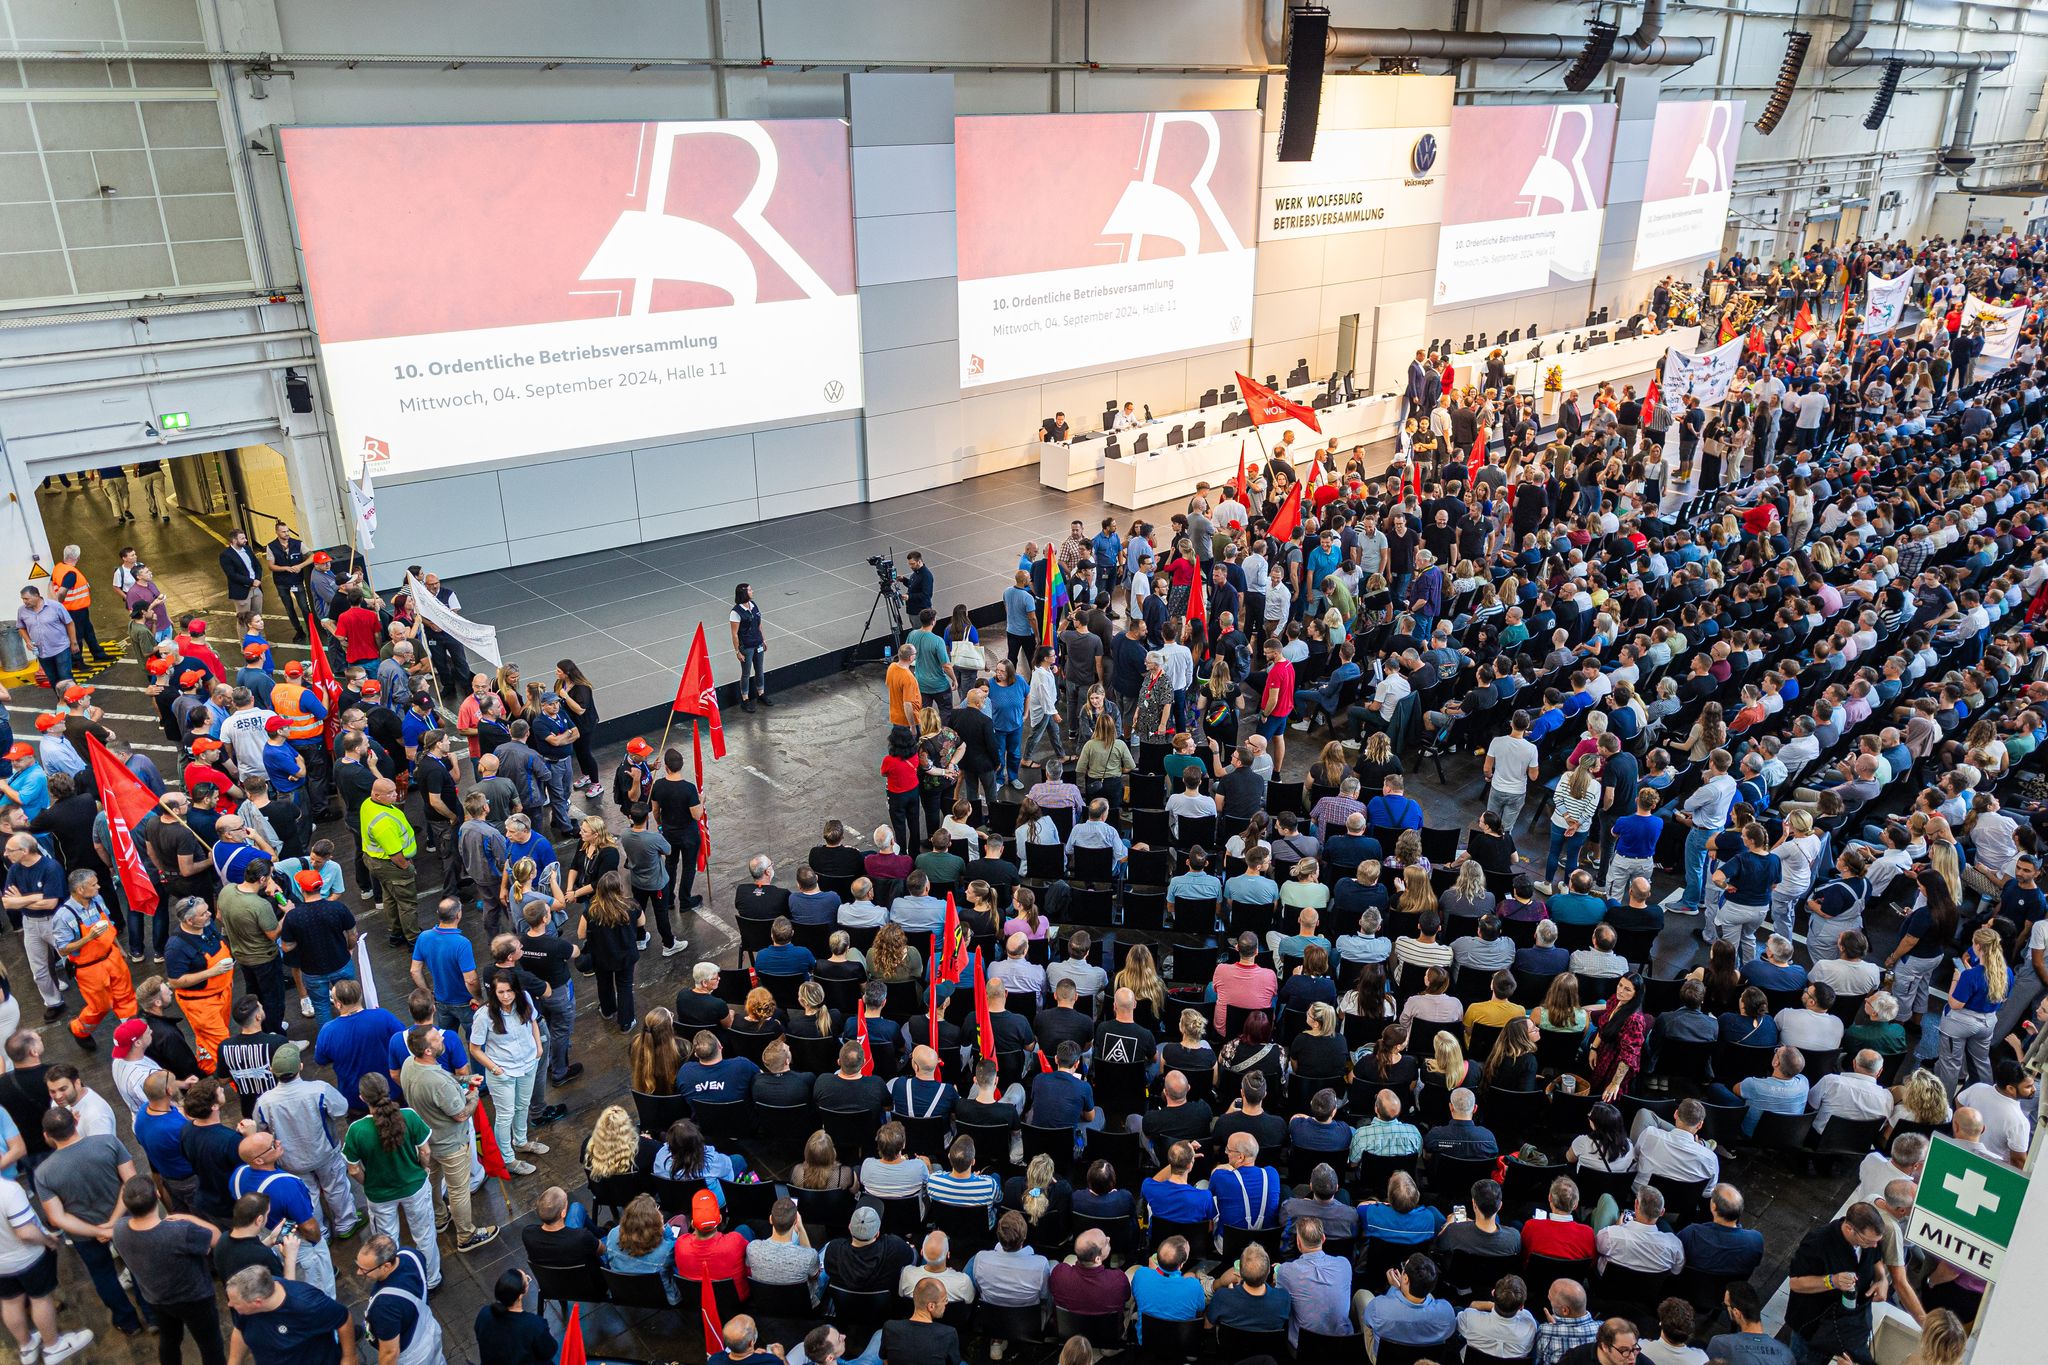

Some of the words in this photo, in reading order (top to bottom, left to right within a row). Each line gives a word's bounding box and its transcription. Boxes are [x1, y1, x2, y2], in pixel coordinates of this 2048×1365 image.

[1404, 178, 1434, 187] Volkswagen
[1275, 197, 1303, 211] WERK
[1307, 192, 1363, 208] WOLFSBURG
[1274, 208, 1385, 230] BETRIEBSVERSAMMLUNG
[993, 298, 1009, 311] 10.
[1012, 291, 1071, 307] Ordentliche
[1074, 279, 1174, 300] Betriebsversammlung
[993, 320, 1043, 337] Mittwoch,
[1045, 317, 1060, 330] 04.
[1063, 309, 1113, 328] September
[1116, 304, 1141, 320] 2024,
[394, 364, 424, 380] 10.
[428, 353, 535, 376] Ordentliche
[539, 335, 718, 364] Betriebsversammlung
[399, 389, 488, 413] Mittwoch,
[493, 386, 520, 402] 04.
[525, 376, 614, 399] September
[618, 369, 663, 388] 2024,
[666, 364, 704, 382] Halle
[709, 361, 727, 376] 11
[695, 1080, 725, 1092] SVEN
[1919, 1222, 1994, 1270] MITTE
